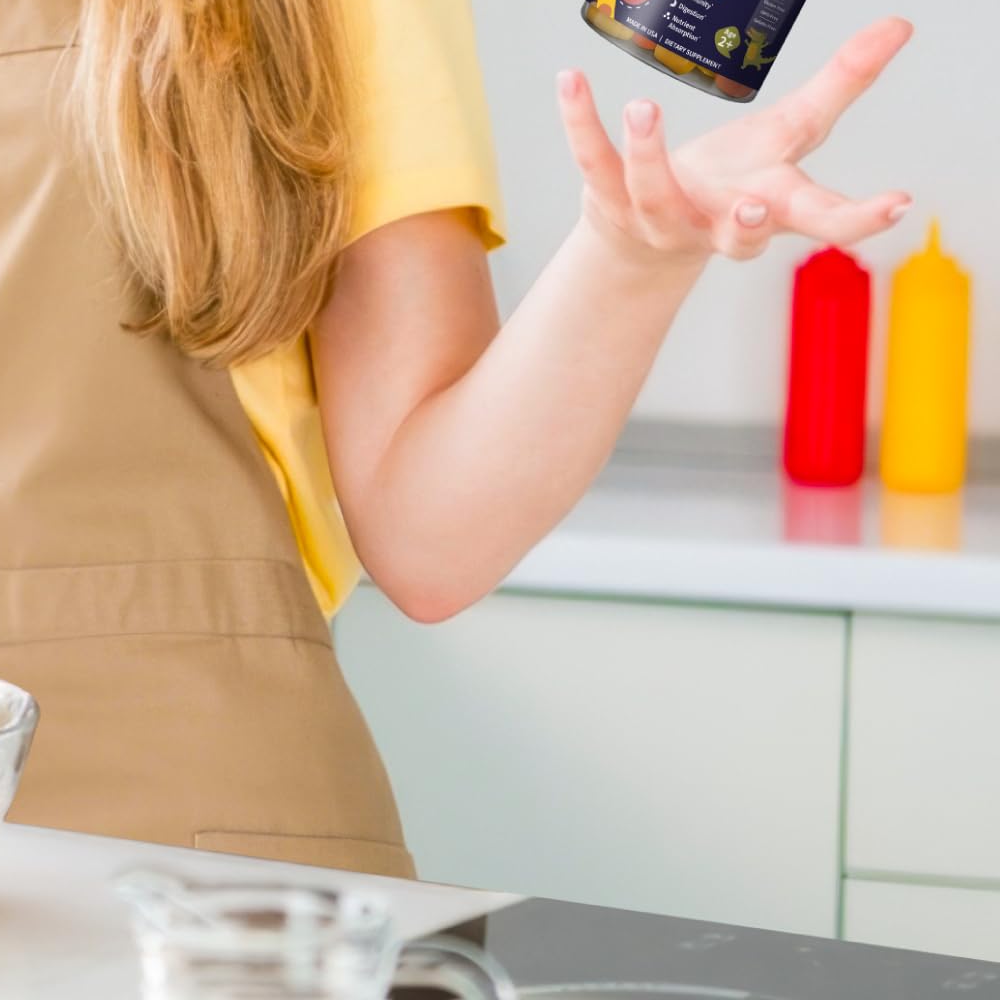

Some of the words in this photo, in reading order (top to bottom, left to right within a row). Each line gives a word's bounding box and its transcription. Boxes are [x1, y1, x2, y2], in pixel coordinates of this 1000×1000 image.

[671, 15, 696, 32] Nutrient
[626, 16, 641, 28] MADE
[646, 27, 658, 38] USA
[664, 38, 686, 52] DIETARY
[686, 49, 721, 69] SUPPLEMENT
[717, 36, 734, 48] 2+
